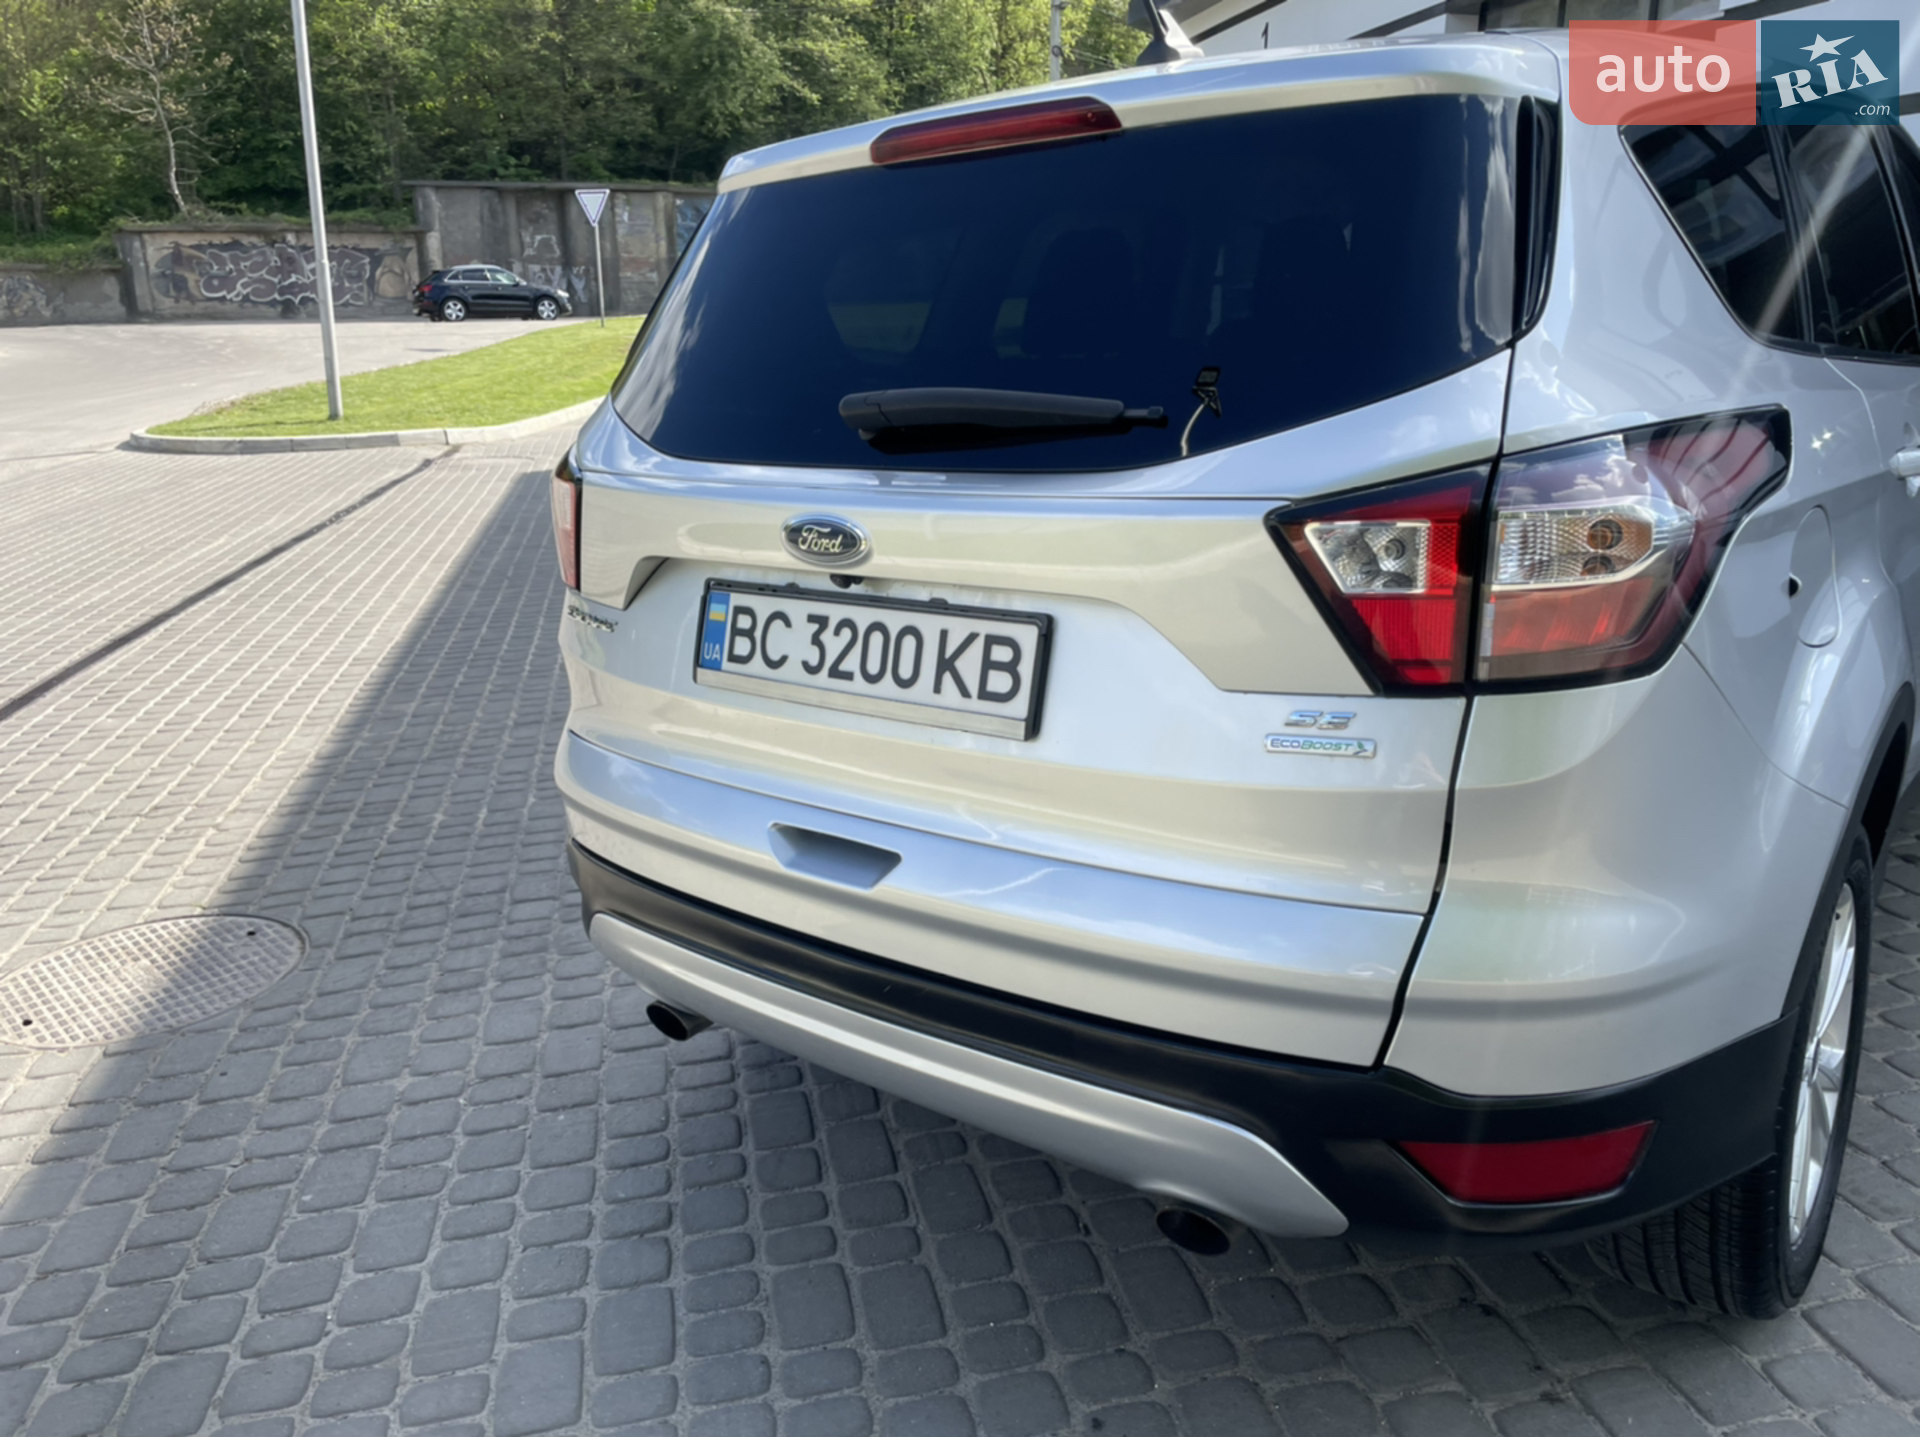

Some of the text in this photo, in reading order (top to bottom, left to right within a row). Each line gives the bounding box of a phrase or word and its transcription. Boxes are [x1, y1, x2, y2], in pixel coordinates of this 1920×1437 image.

[798, 524, 844, 553] Ford
[703, 641, 721, 662] UA
[727, 605, 1022, 704] BC 3200 KB
[1284, 710, 1357, 730] SE
